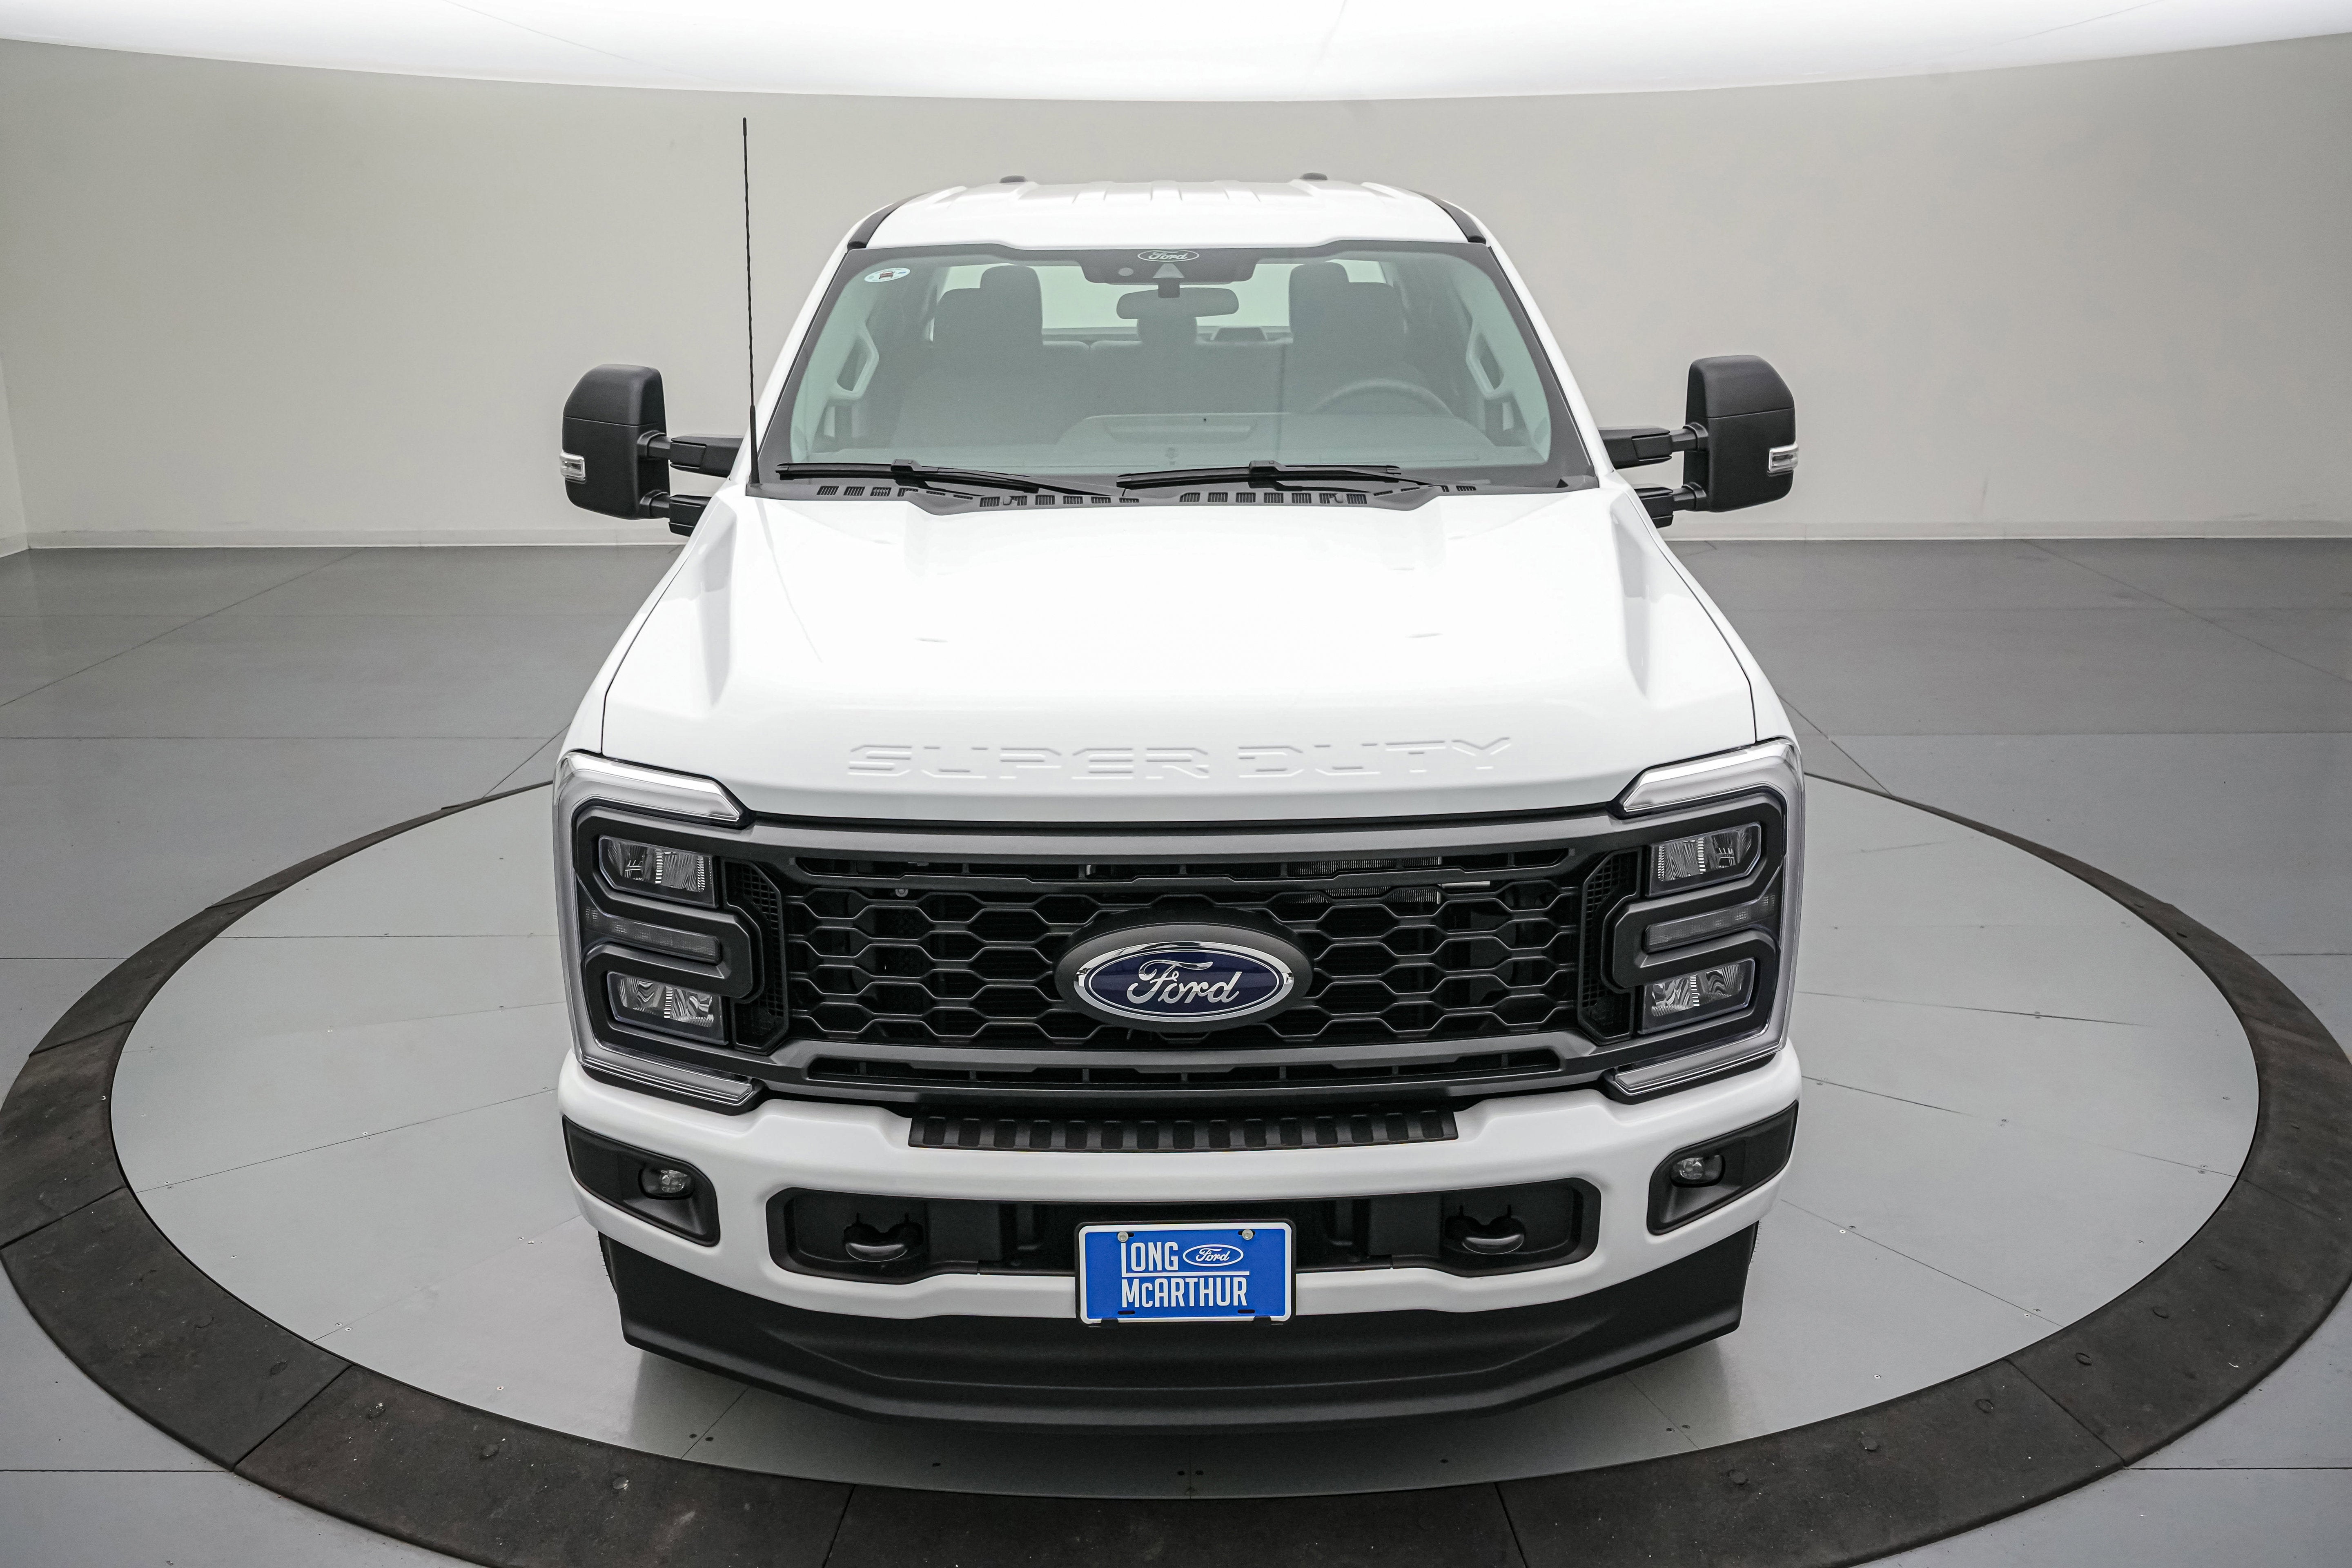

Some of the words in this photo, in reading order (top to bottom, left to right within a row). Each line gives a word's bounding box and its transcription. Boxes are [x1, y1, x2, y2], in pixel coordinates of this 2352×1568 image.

[1148, 251, 1189, 260] Ford
[846, 744, 1212, 780] SUPER
[1237, 735, 1512, 778] DUTY
[1127, 960, 1242, 1004] Ford
[1121, 1242, 1178, 1277] LONG
[1195, 1248, 1231, 1262] Ford
[1121, 1277, 1247, 1307] McARTHUR
